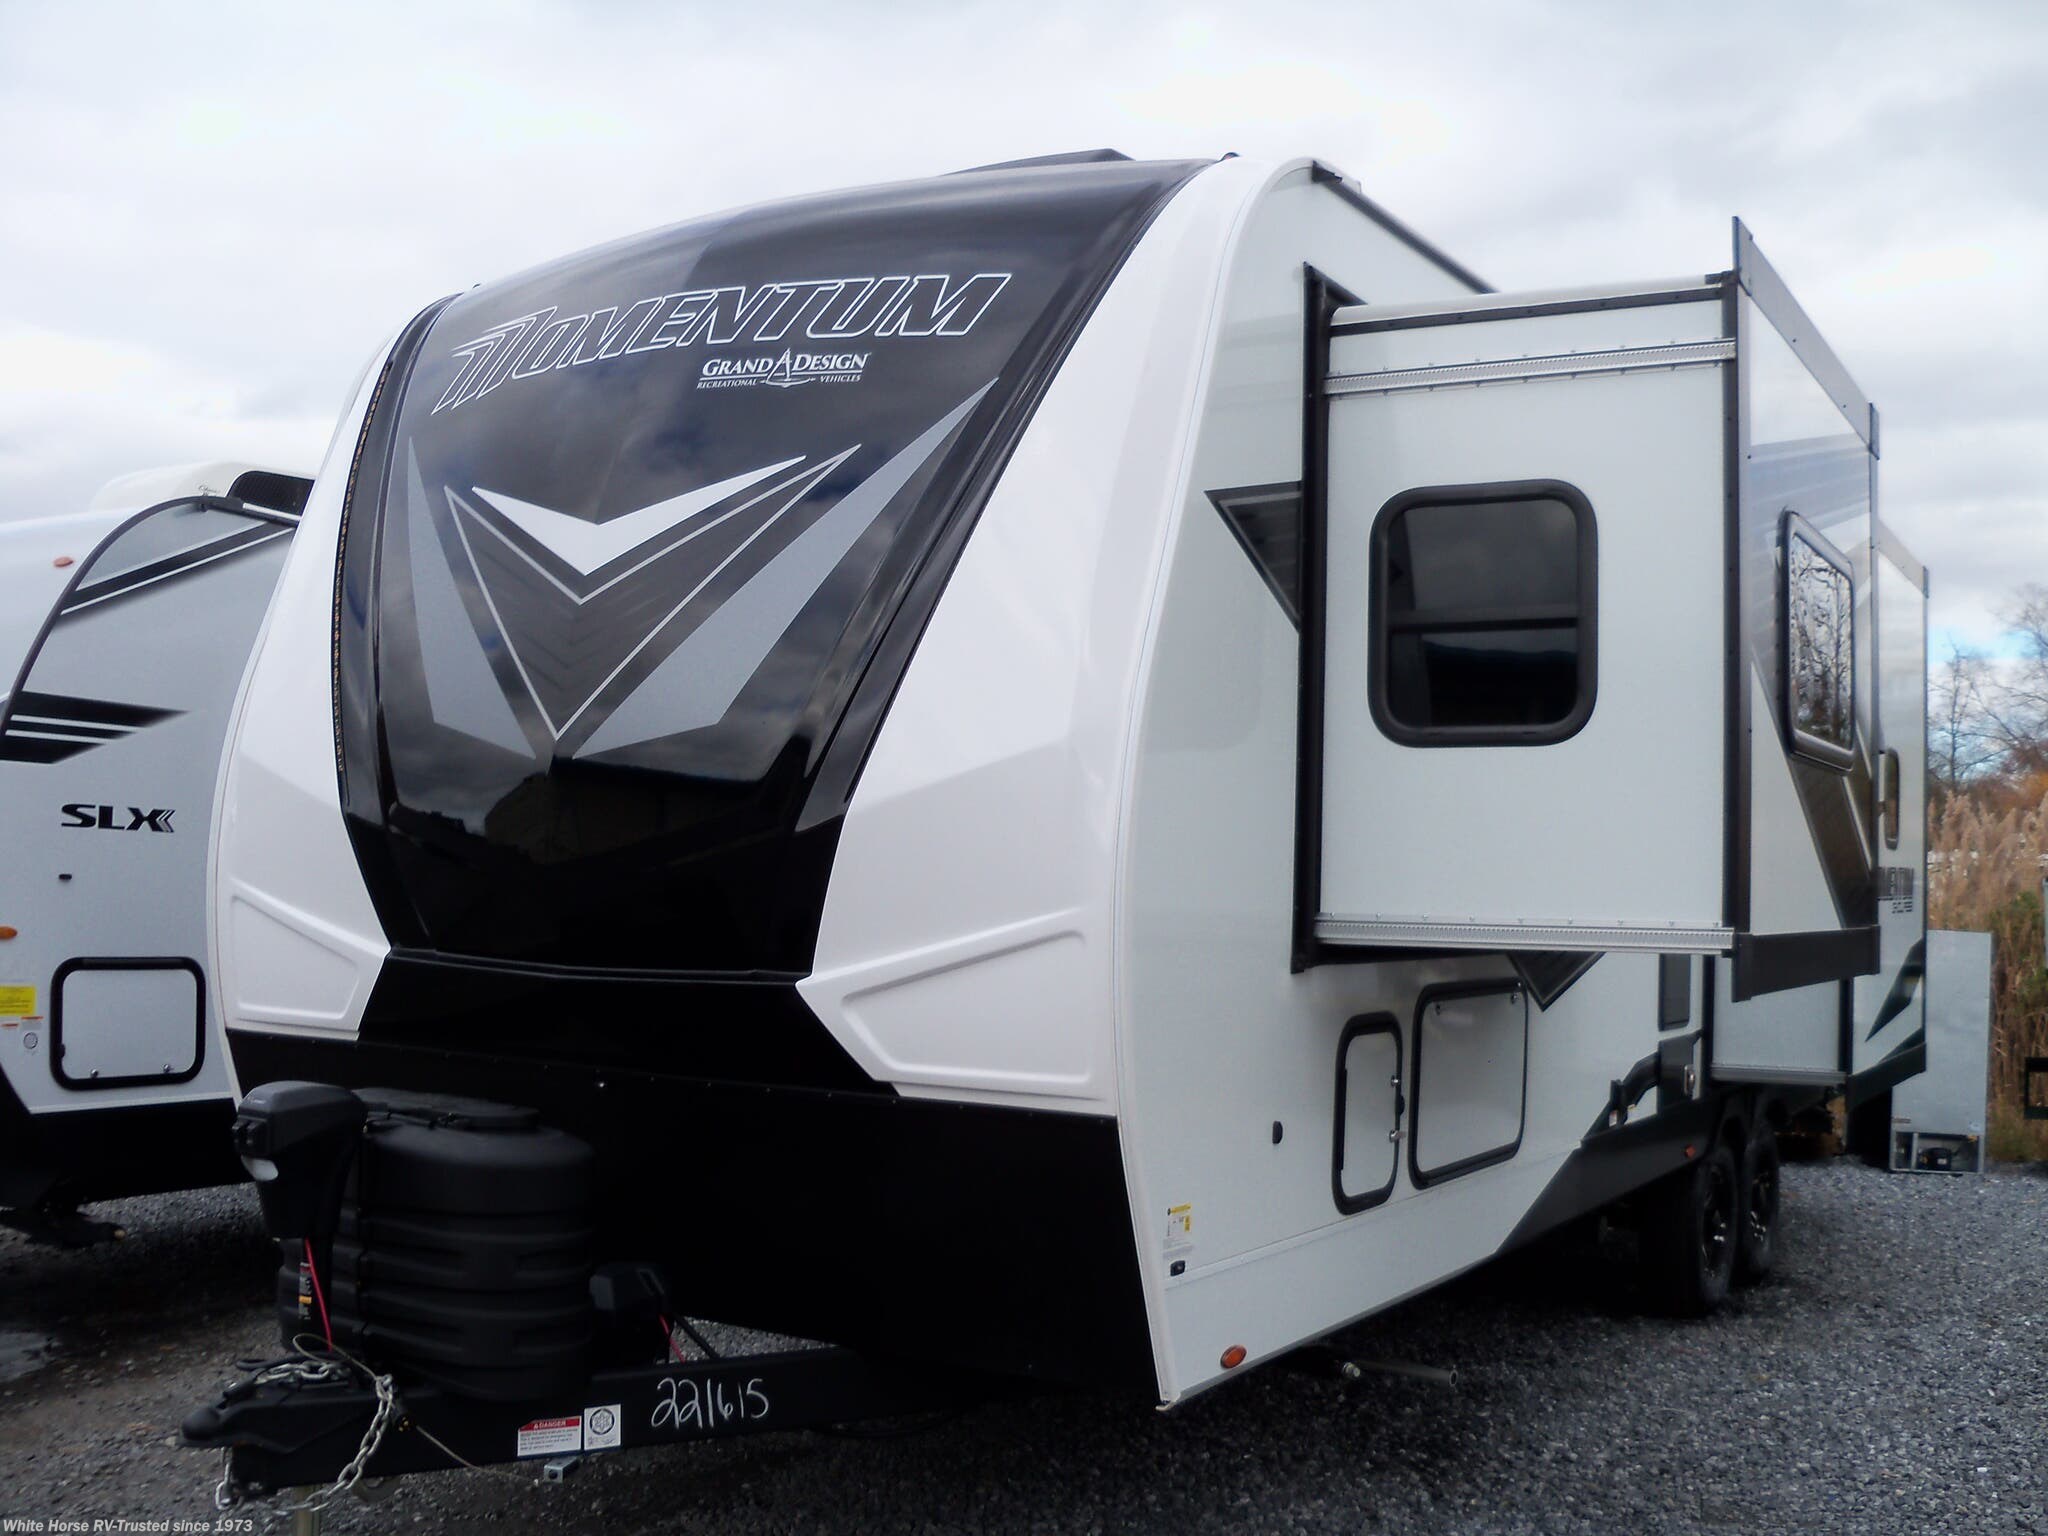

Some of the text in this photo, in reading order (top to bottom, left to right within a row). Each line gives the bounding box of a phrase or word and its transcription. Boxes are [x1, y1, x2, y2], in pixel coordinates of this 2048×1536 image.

[431, 272, 1013, 416] MOMENTUM
[702, 352, 869, 377] GRAND DESIGN
[696, 374, 862, 390] RECREATIONAL VEHICLES
[61, 803, 176, 833] SLX
[651, 1376, 770, 1430] 221615
